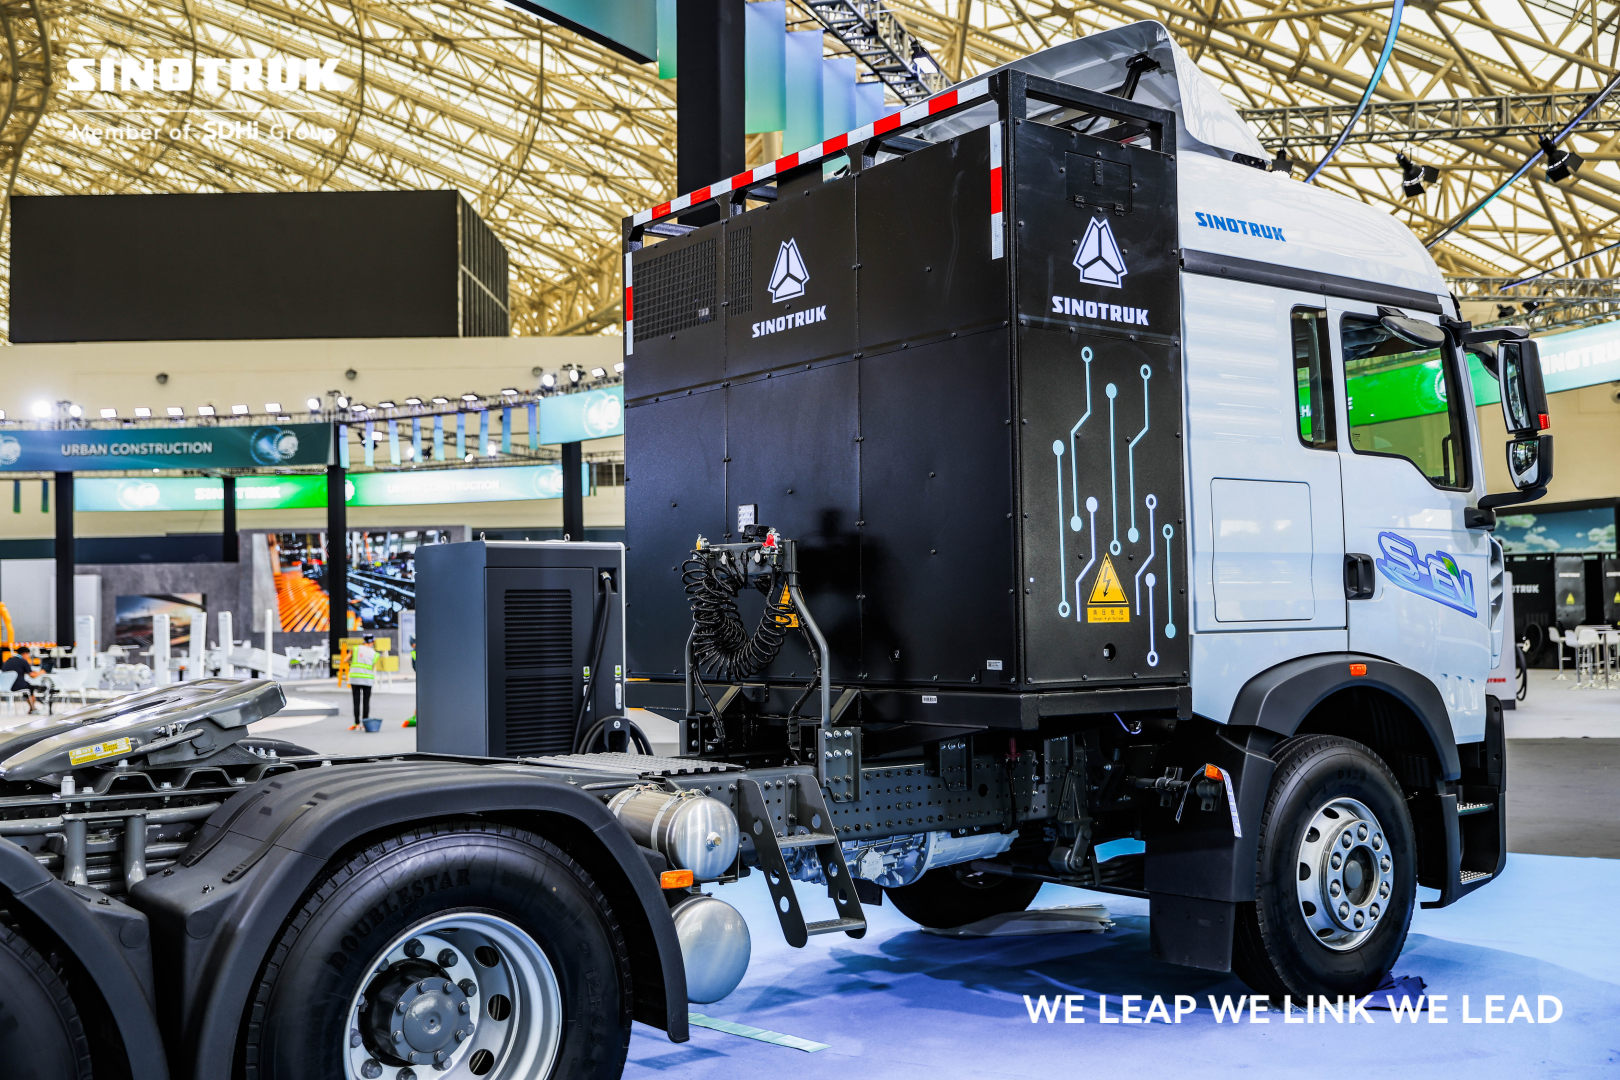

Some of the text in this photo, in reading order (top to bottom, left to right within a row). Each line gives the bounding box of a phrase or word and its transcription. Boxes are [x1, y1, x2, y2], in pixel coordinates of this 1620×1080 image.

[1194, 211, 1286, 242] SINOTRUK
[751, 304, 827, 338] SINOTRUK
[1051, 295, 1149, 326] SINOTRUK
[61, 441, 213, 456] URBAN CONSTRUCTION
